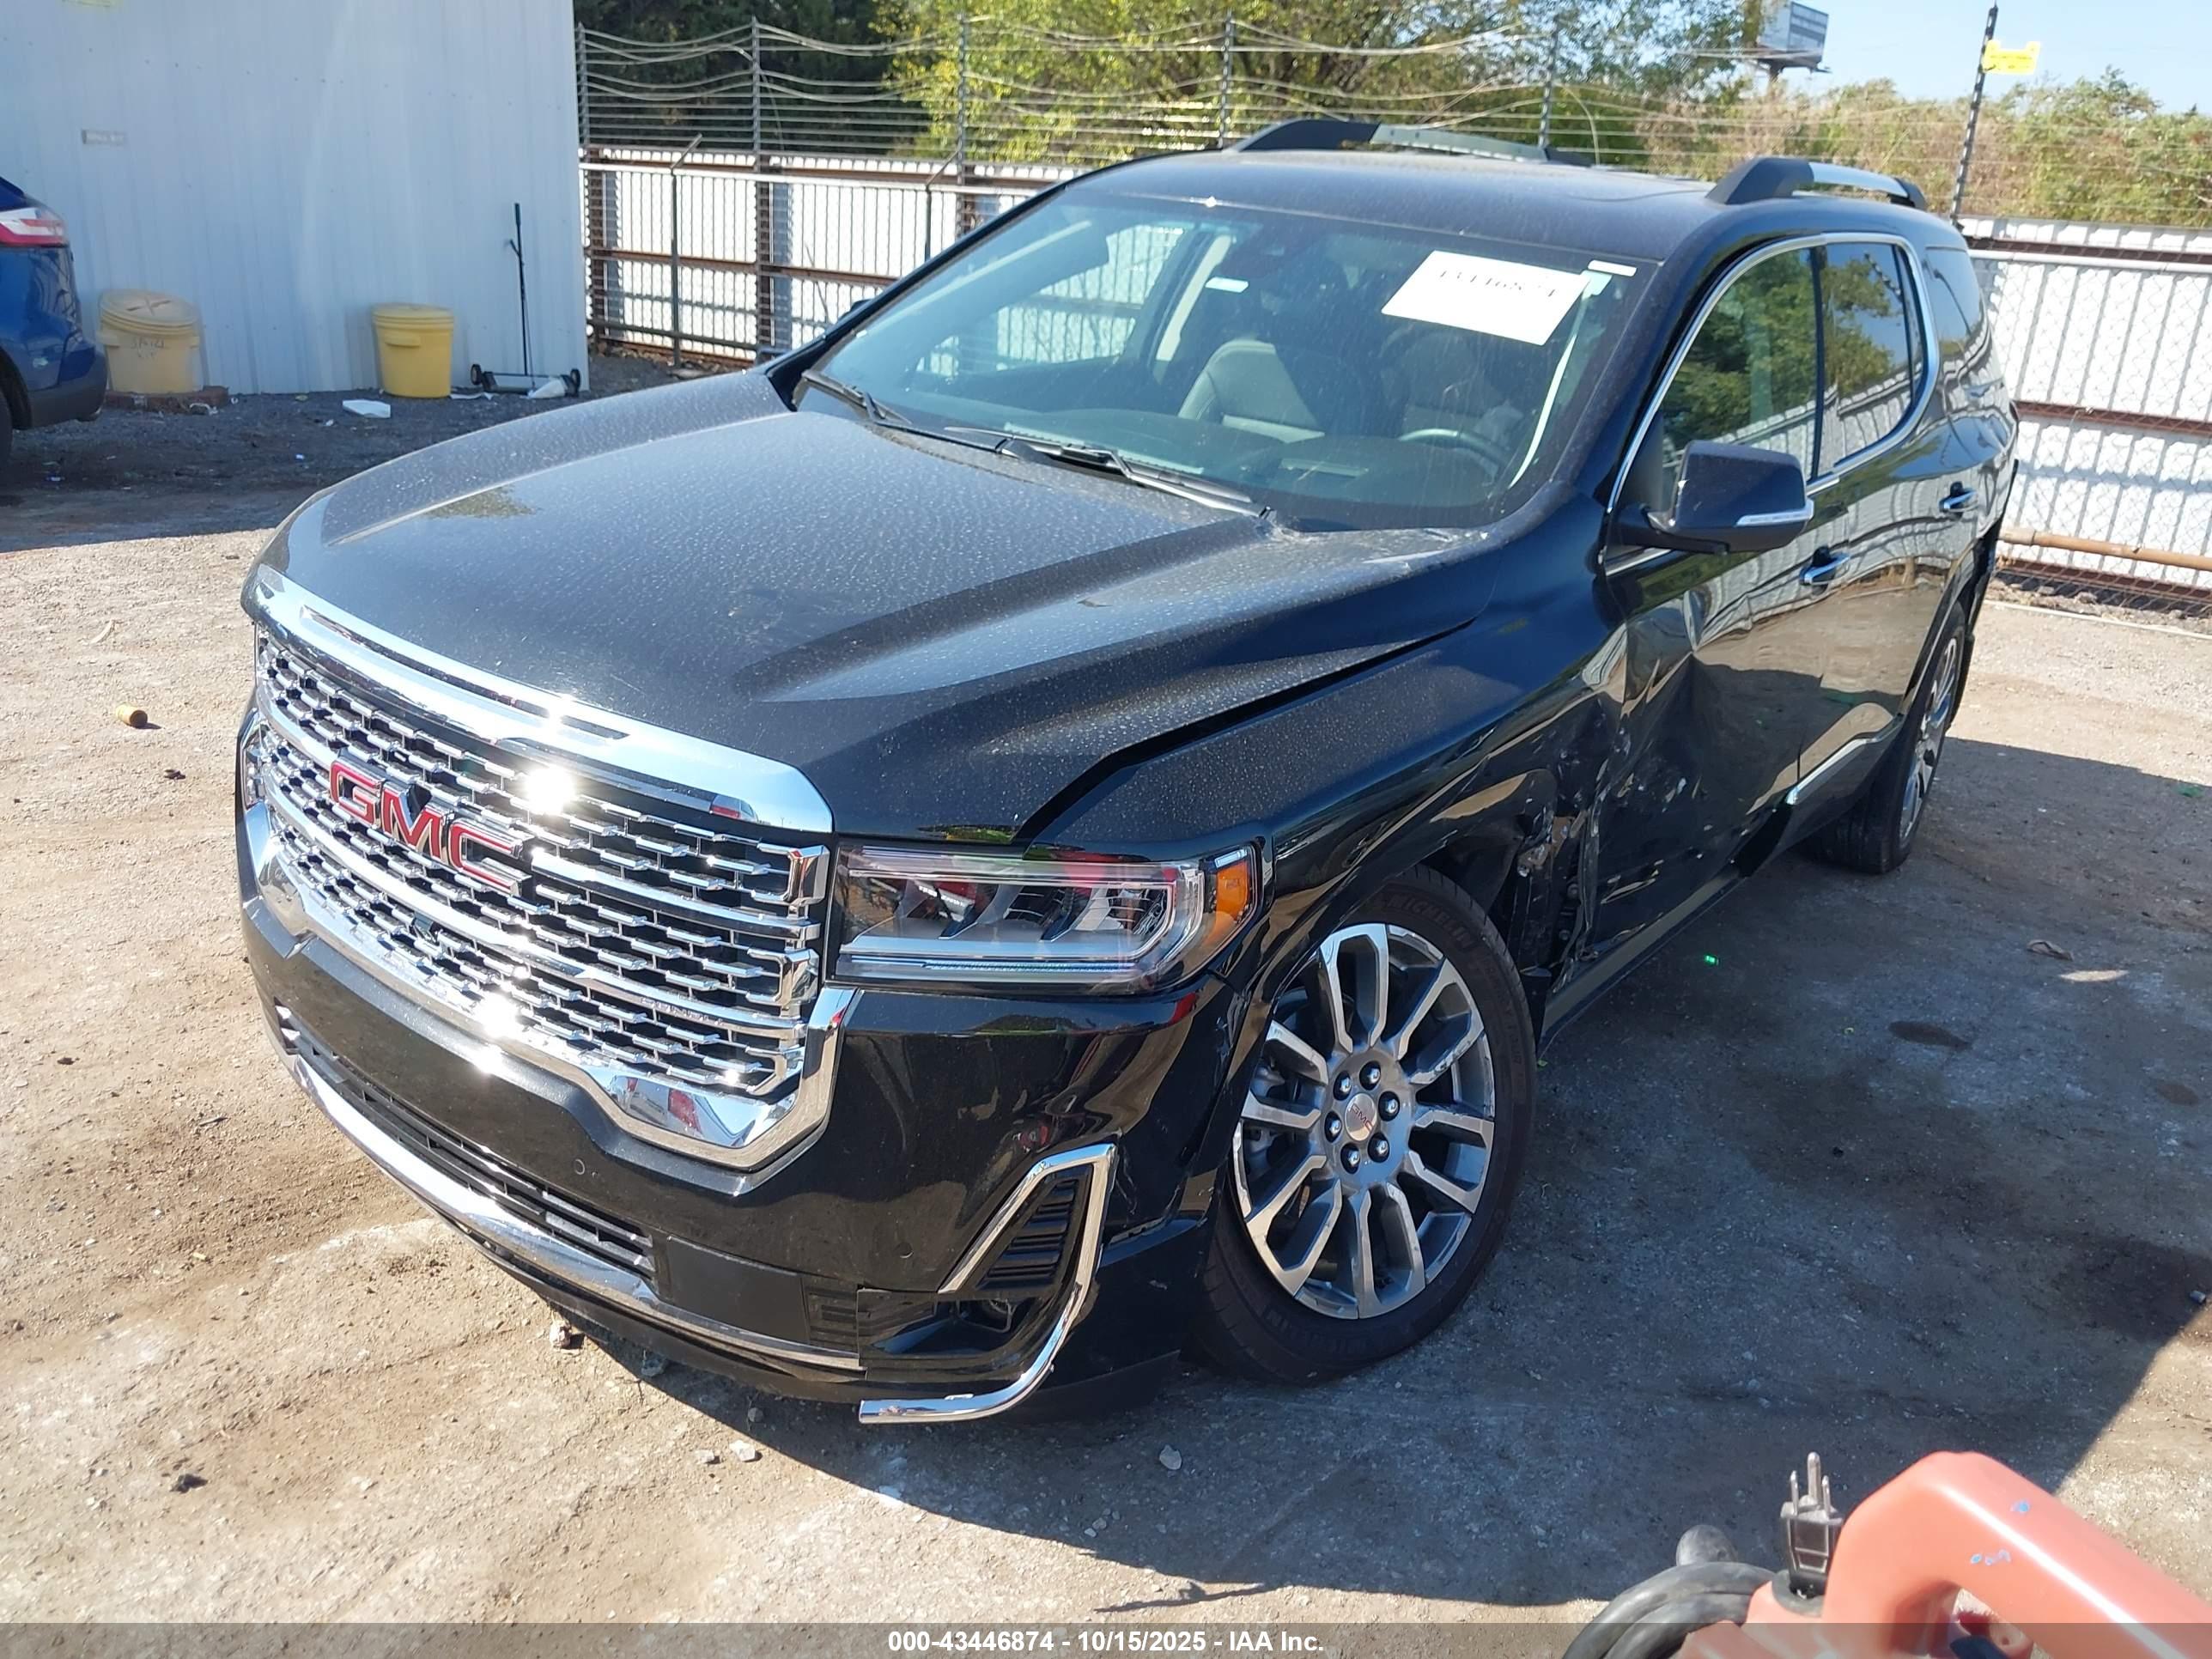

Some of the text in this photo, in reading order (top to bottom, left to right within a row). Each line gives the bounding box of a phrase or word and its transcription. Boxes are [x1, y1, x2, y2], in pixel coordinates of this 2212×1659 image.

[329, 753, 530, 896] GMC
[1388, 894, 1475, 949] MICHELIN
[639, 996, 726, 1026] DENALI
[1349, 1103, 1376, 1132] GMC
